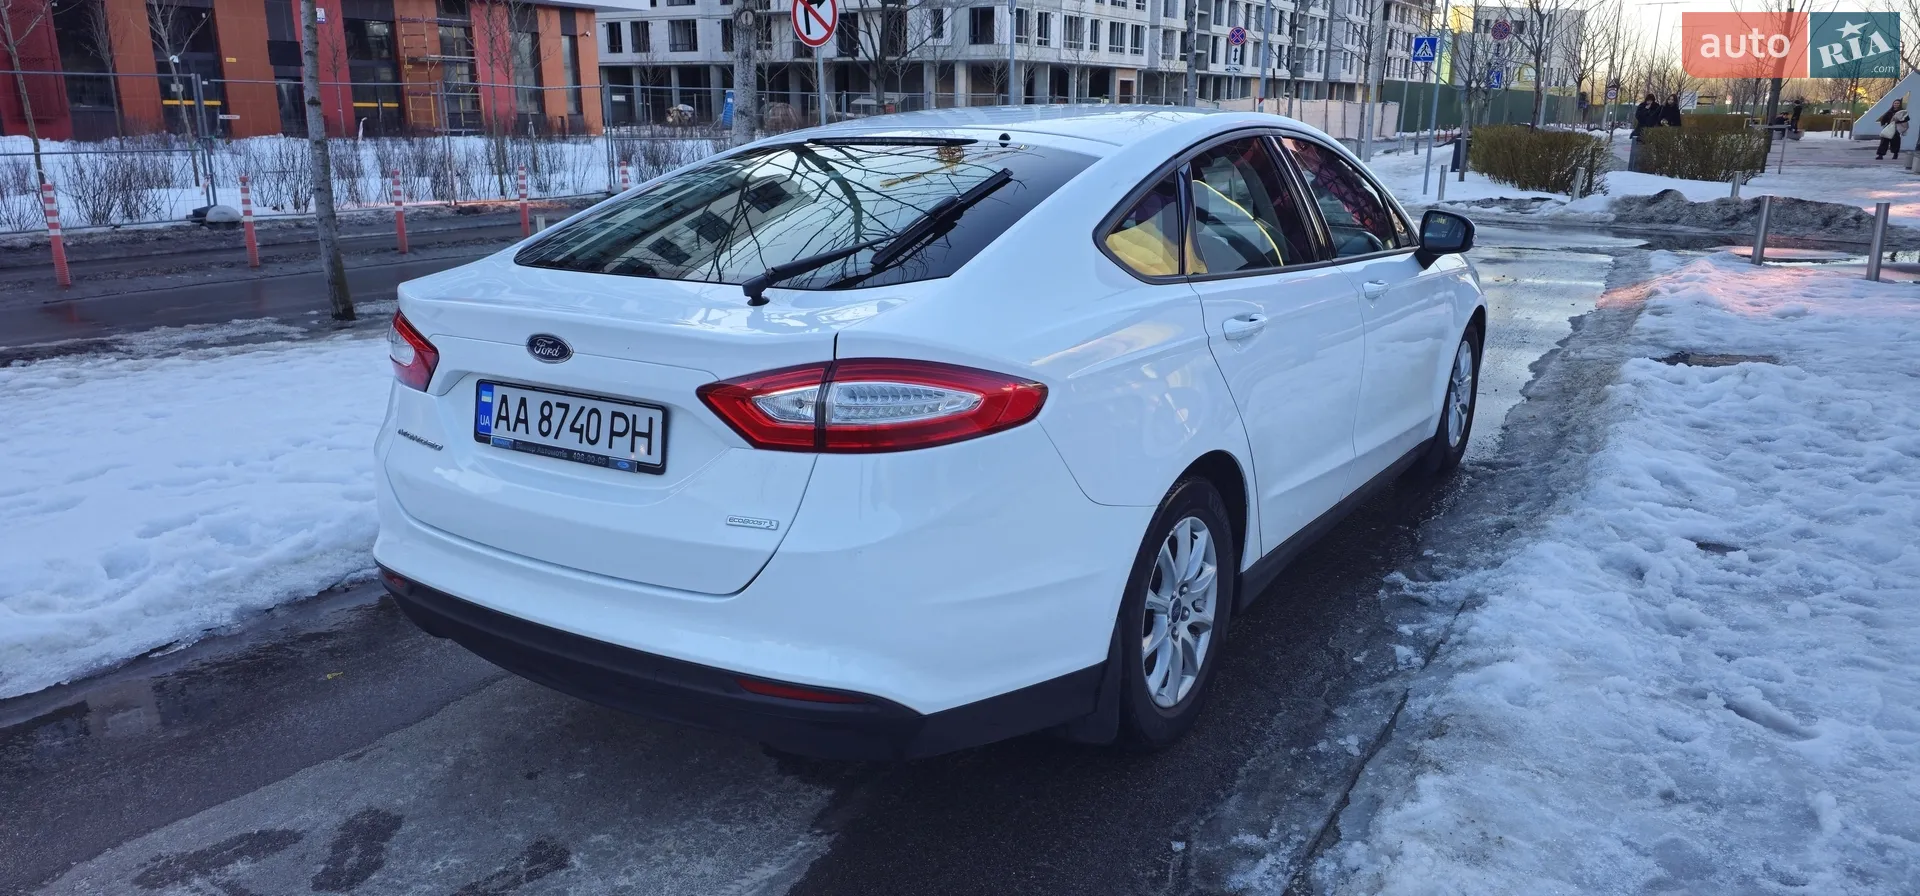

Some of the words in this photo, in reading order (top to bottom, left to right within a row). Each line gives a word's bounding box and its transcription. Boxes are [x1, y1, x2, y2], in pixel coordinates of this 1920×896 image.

[534, 338, 561, 357] Ford
[479, 414, 490, 427] UA
[494, 394, 530, 435] AA
[537, 400, 602, 446] 8740
[608, 410, 653, 456] PH
[728, 516, 768, 526] ECOBOOST
